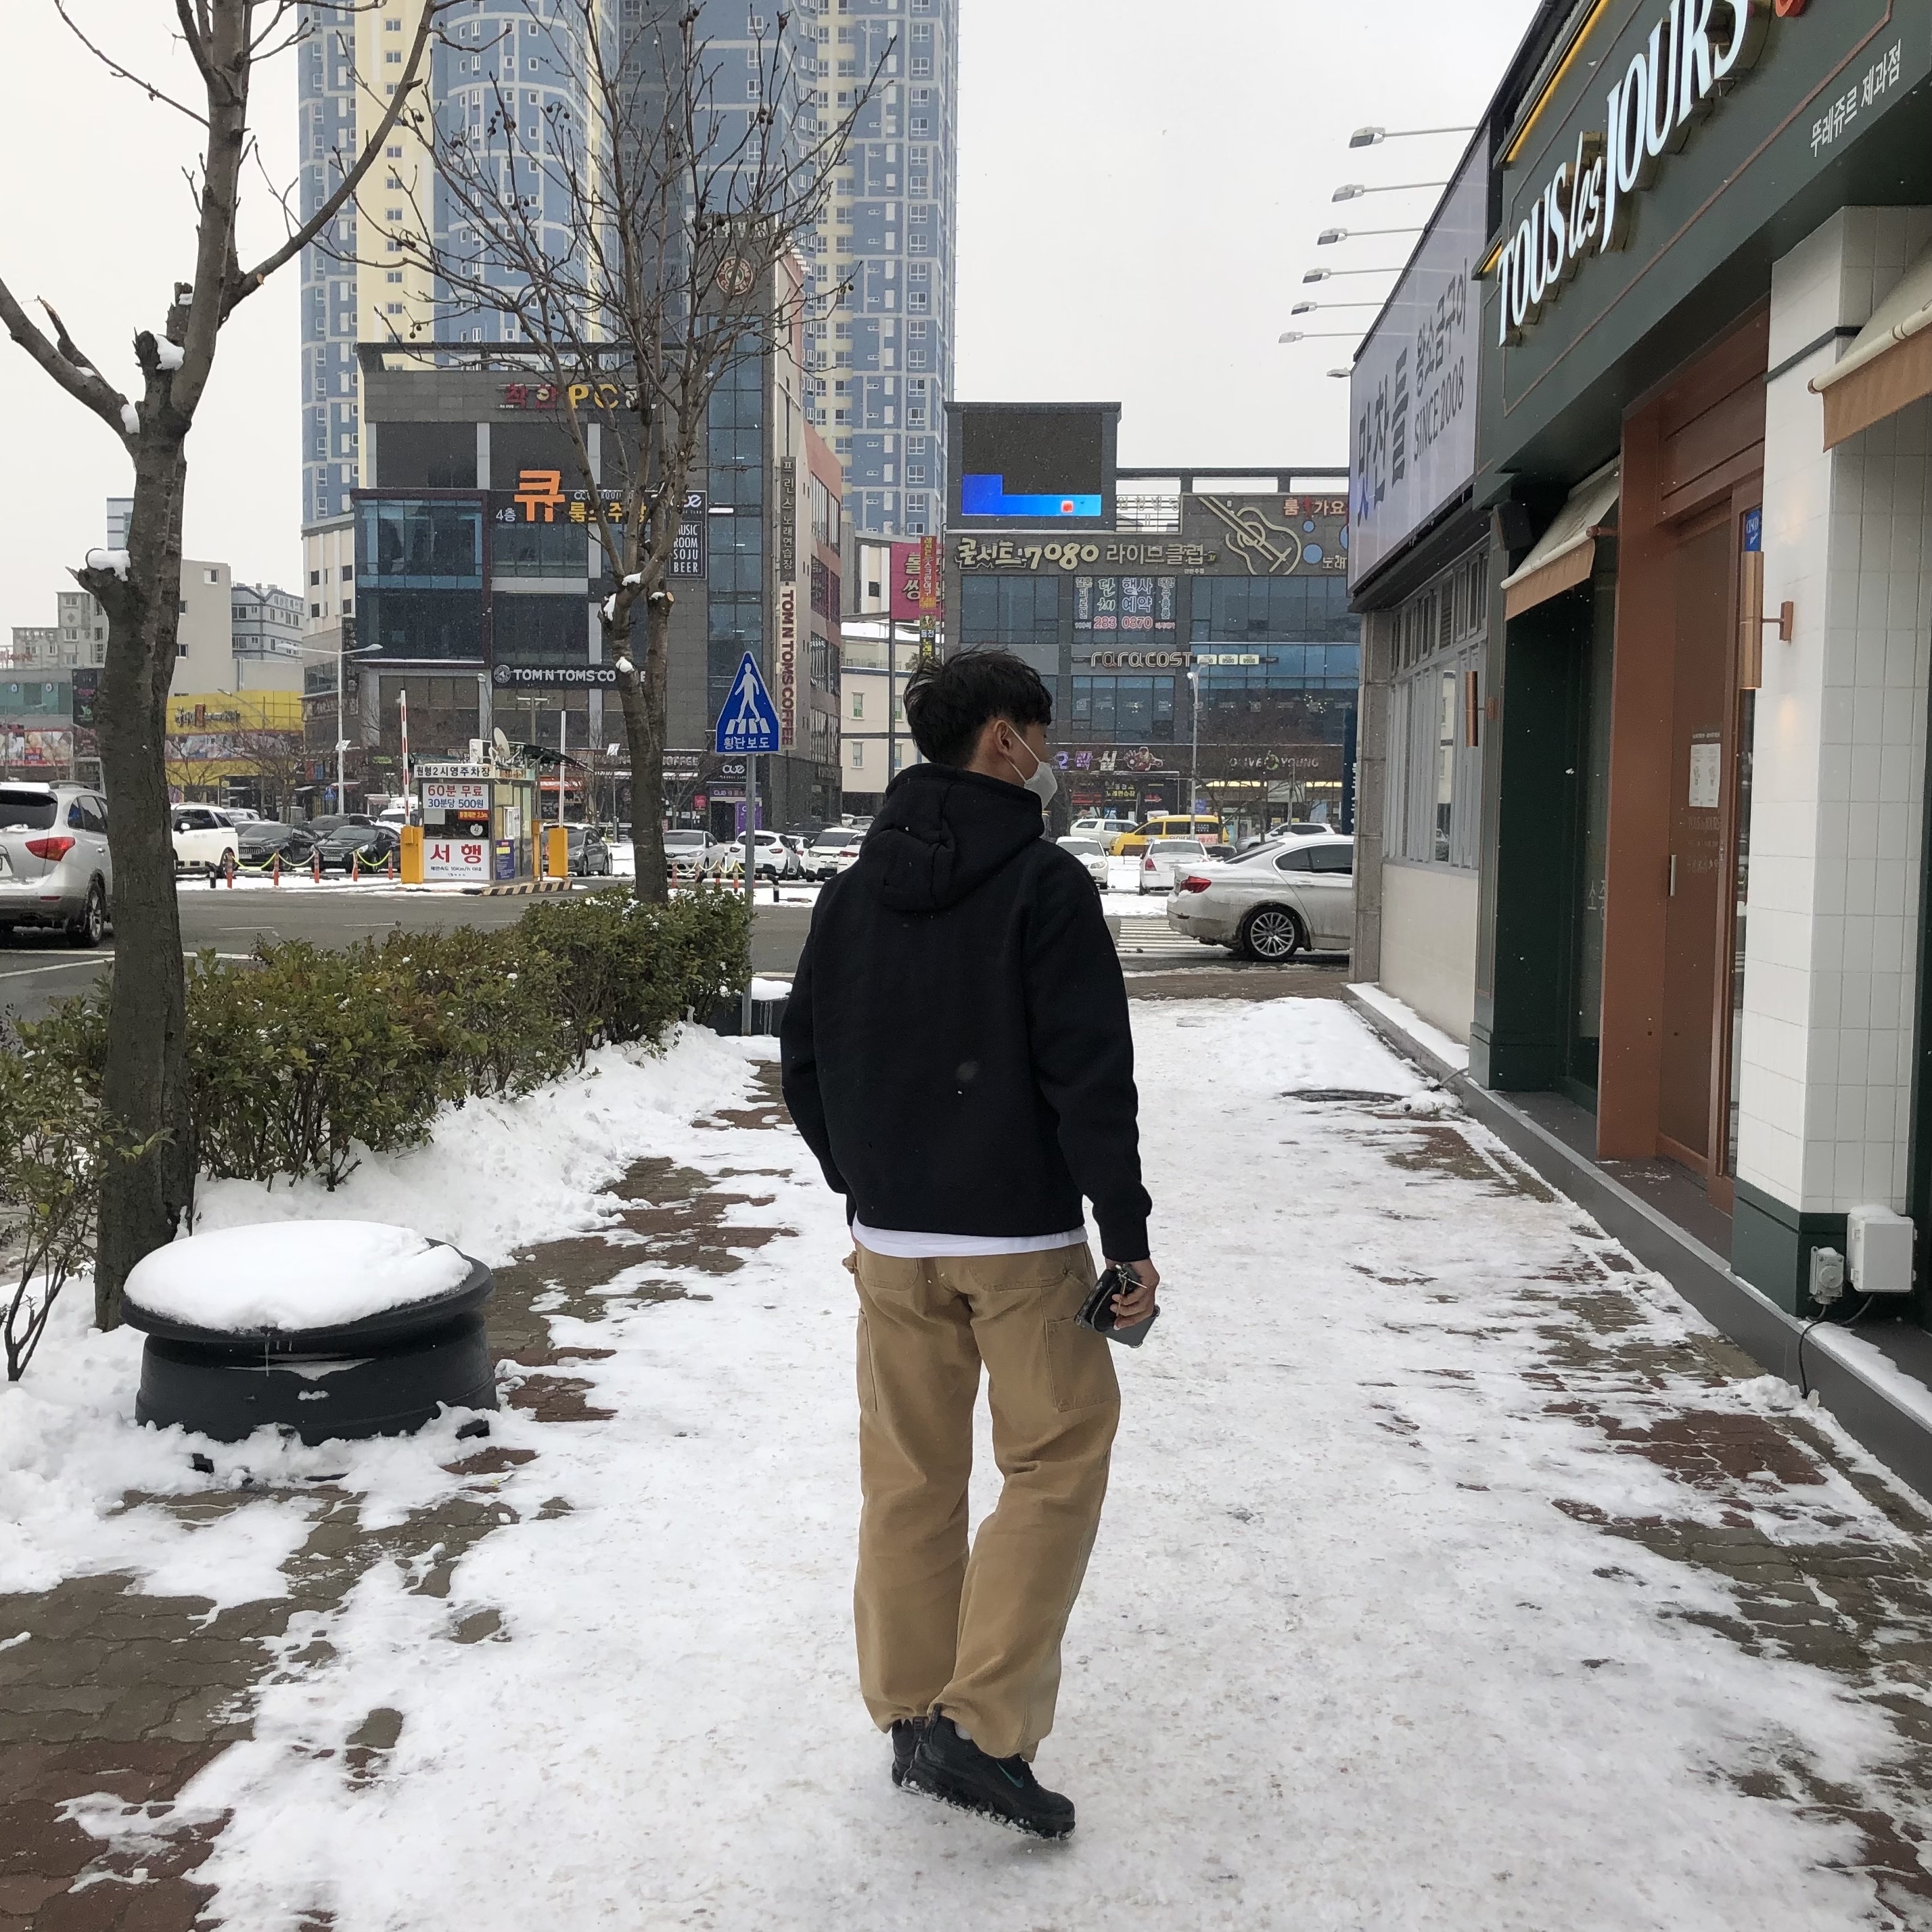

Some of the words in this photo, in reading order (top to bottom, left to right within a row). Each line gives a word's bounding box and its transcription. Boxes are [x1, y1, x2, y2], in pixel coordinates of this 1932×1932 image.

[1810, 85, 1858, 158] 뚜레쥬르
[1861, 38, 1902, 108] 제과점
[1498, 162, 1566, 347] TOUS
[1569, 131, 1601, 258] les
[1416, 256, 1467, 398] 왕소금구이
[1414, 387, 1439, 462] SINCE
[1440, 355, 1465, 433] 2008
[1356, 347, 1409, 528] 맛찬들
[782, 461, 794, 509] 프린스
[514, 470, 566, 522] 큐
[496, 508, 516, 522] 4층
[1284, 497, 1300, 516] 룸
[673, 537, 698, 549] ROOM
[782, 515, 794, 571] 노래연습장
[673, 549, 699, 560] SOJU
[1106, 543, 1205, 566] 라이브클럽
[673, 561, 699, 573] BEER
[1122, 577, 1153, 596] 행사
[781, 589, 795, 624] TOM
[1122, 596, 1153, 614] 예약
[781, 626, 795, 639] N
[1093, 616, 1118, 630] 283
[1122, 616, 1154, 630] 0870
[781, 640, 795, 685] TOMS
[1090, 651, 1193, 668] raracost
[513, 669, 543, 681] TOM
[544, 670, 555, 681] N
[556, 670, 595, 682] TOMS
[781, 687, 795, 745] COFFEE
[723, 736, 770, 750] 횡단보도
[428, 785, 457, 798] 60분
[461, 785, 483, 798] 무료
[428, 798, 455, 808] 30분당
[458, 799, 484, 809] 500원
